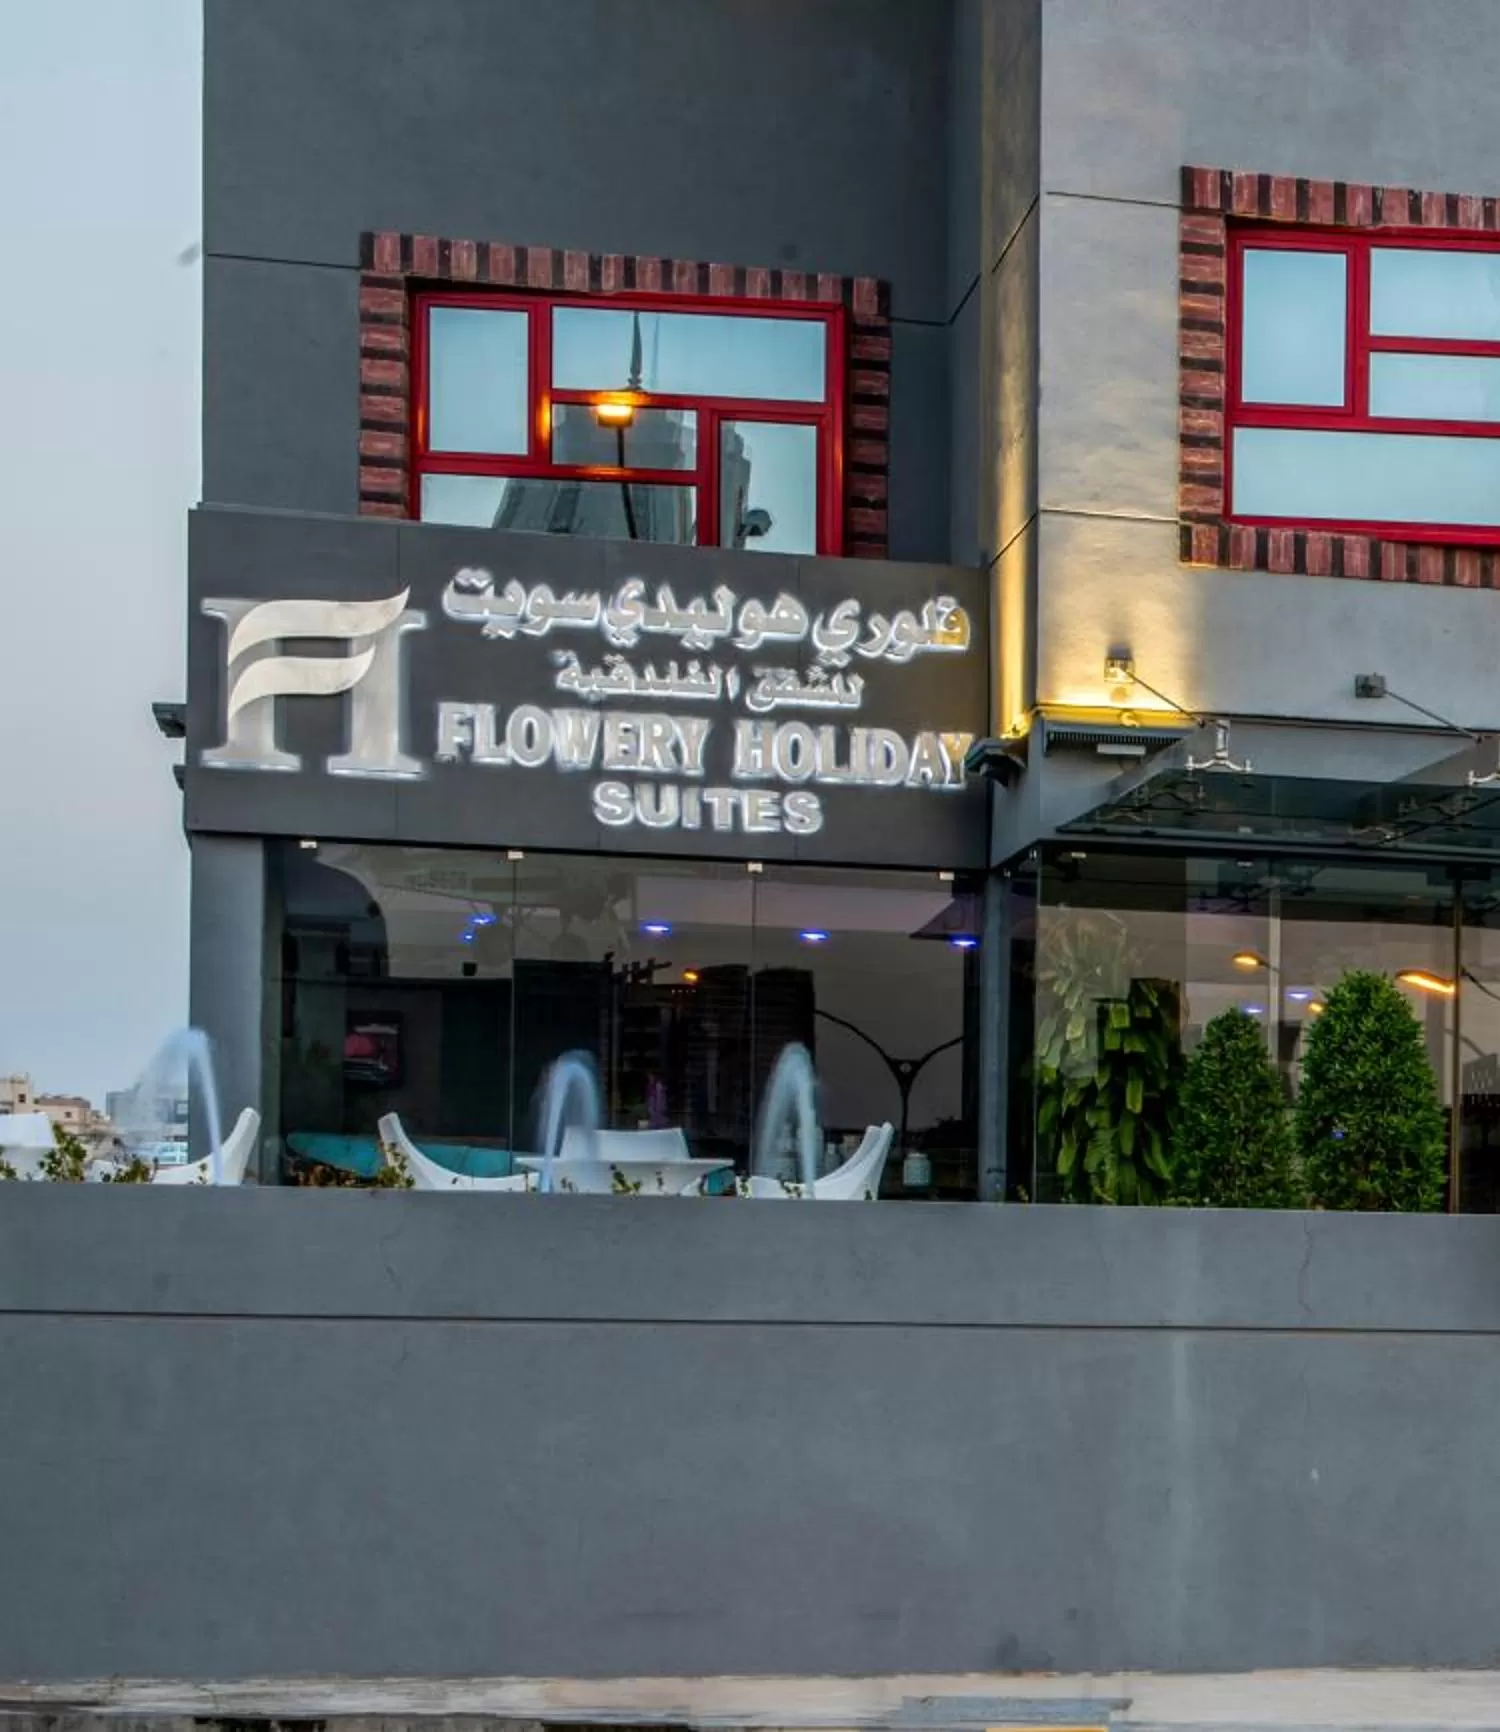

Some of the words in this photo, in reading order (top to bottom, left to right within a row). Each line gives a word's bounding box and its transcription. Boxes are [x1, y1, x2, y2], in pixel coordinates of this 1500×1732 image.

[441, 566, 602, 640] سويت
[603, 576, 810, 651] هوليدي
[813, 595, 972, 664] فلوري
[554, 648, 741, 705] الفندقية
[746, 664, 866, 713] للشقق
[435, 702, 711, 775] FLOWERY
[734, 718, 973, 789] HOLIDAY
[593, 780, 824, 834] SUITES
